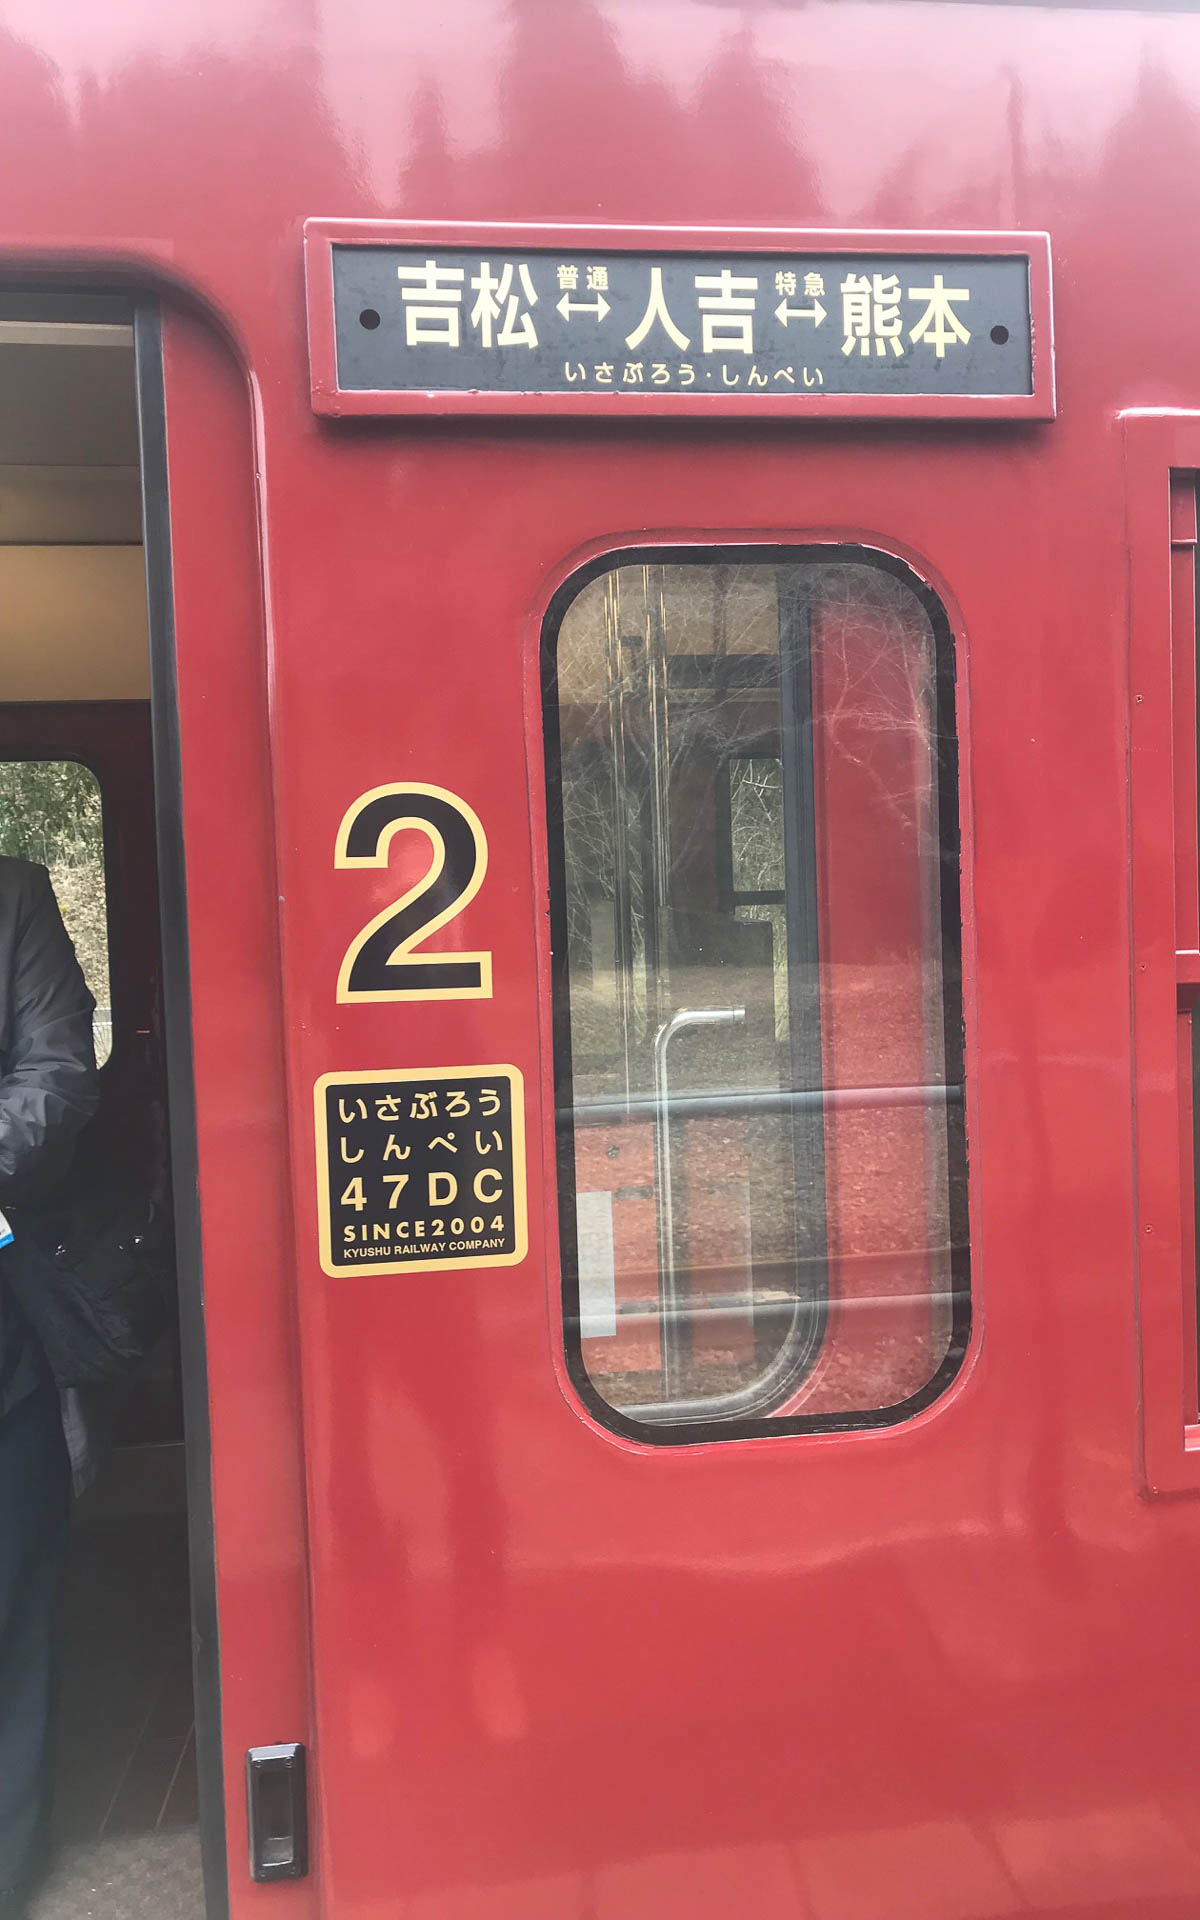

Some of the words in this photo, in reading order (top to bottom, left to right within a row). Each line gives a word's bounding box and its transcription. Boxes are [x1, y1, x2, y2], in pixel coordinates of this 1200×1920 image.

[556, 264, 609, 290] 普通
[775, 271, 826, 296] 特急
[397, 260, 539, 349] 吉松
[624, 267, 758, 354] 人吉
[840, 273, 972, 358] 熊本
[334, 781, 493, 1004] 2
[338, 1088, 501, 1124] いさぶろう
[340, 1129, 503, 1164] しんぺい
[343, 1246, 391, 1258] KYUSHU
[394, 1242, 446, 1254] RAILWAY
[449, 1238, 505, 1250] COMPANY
